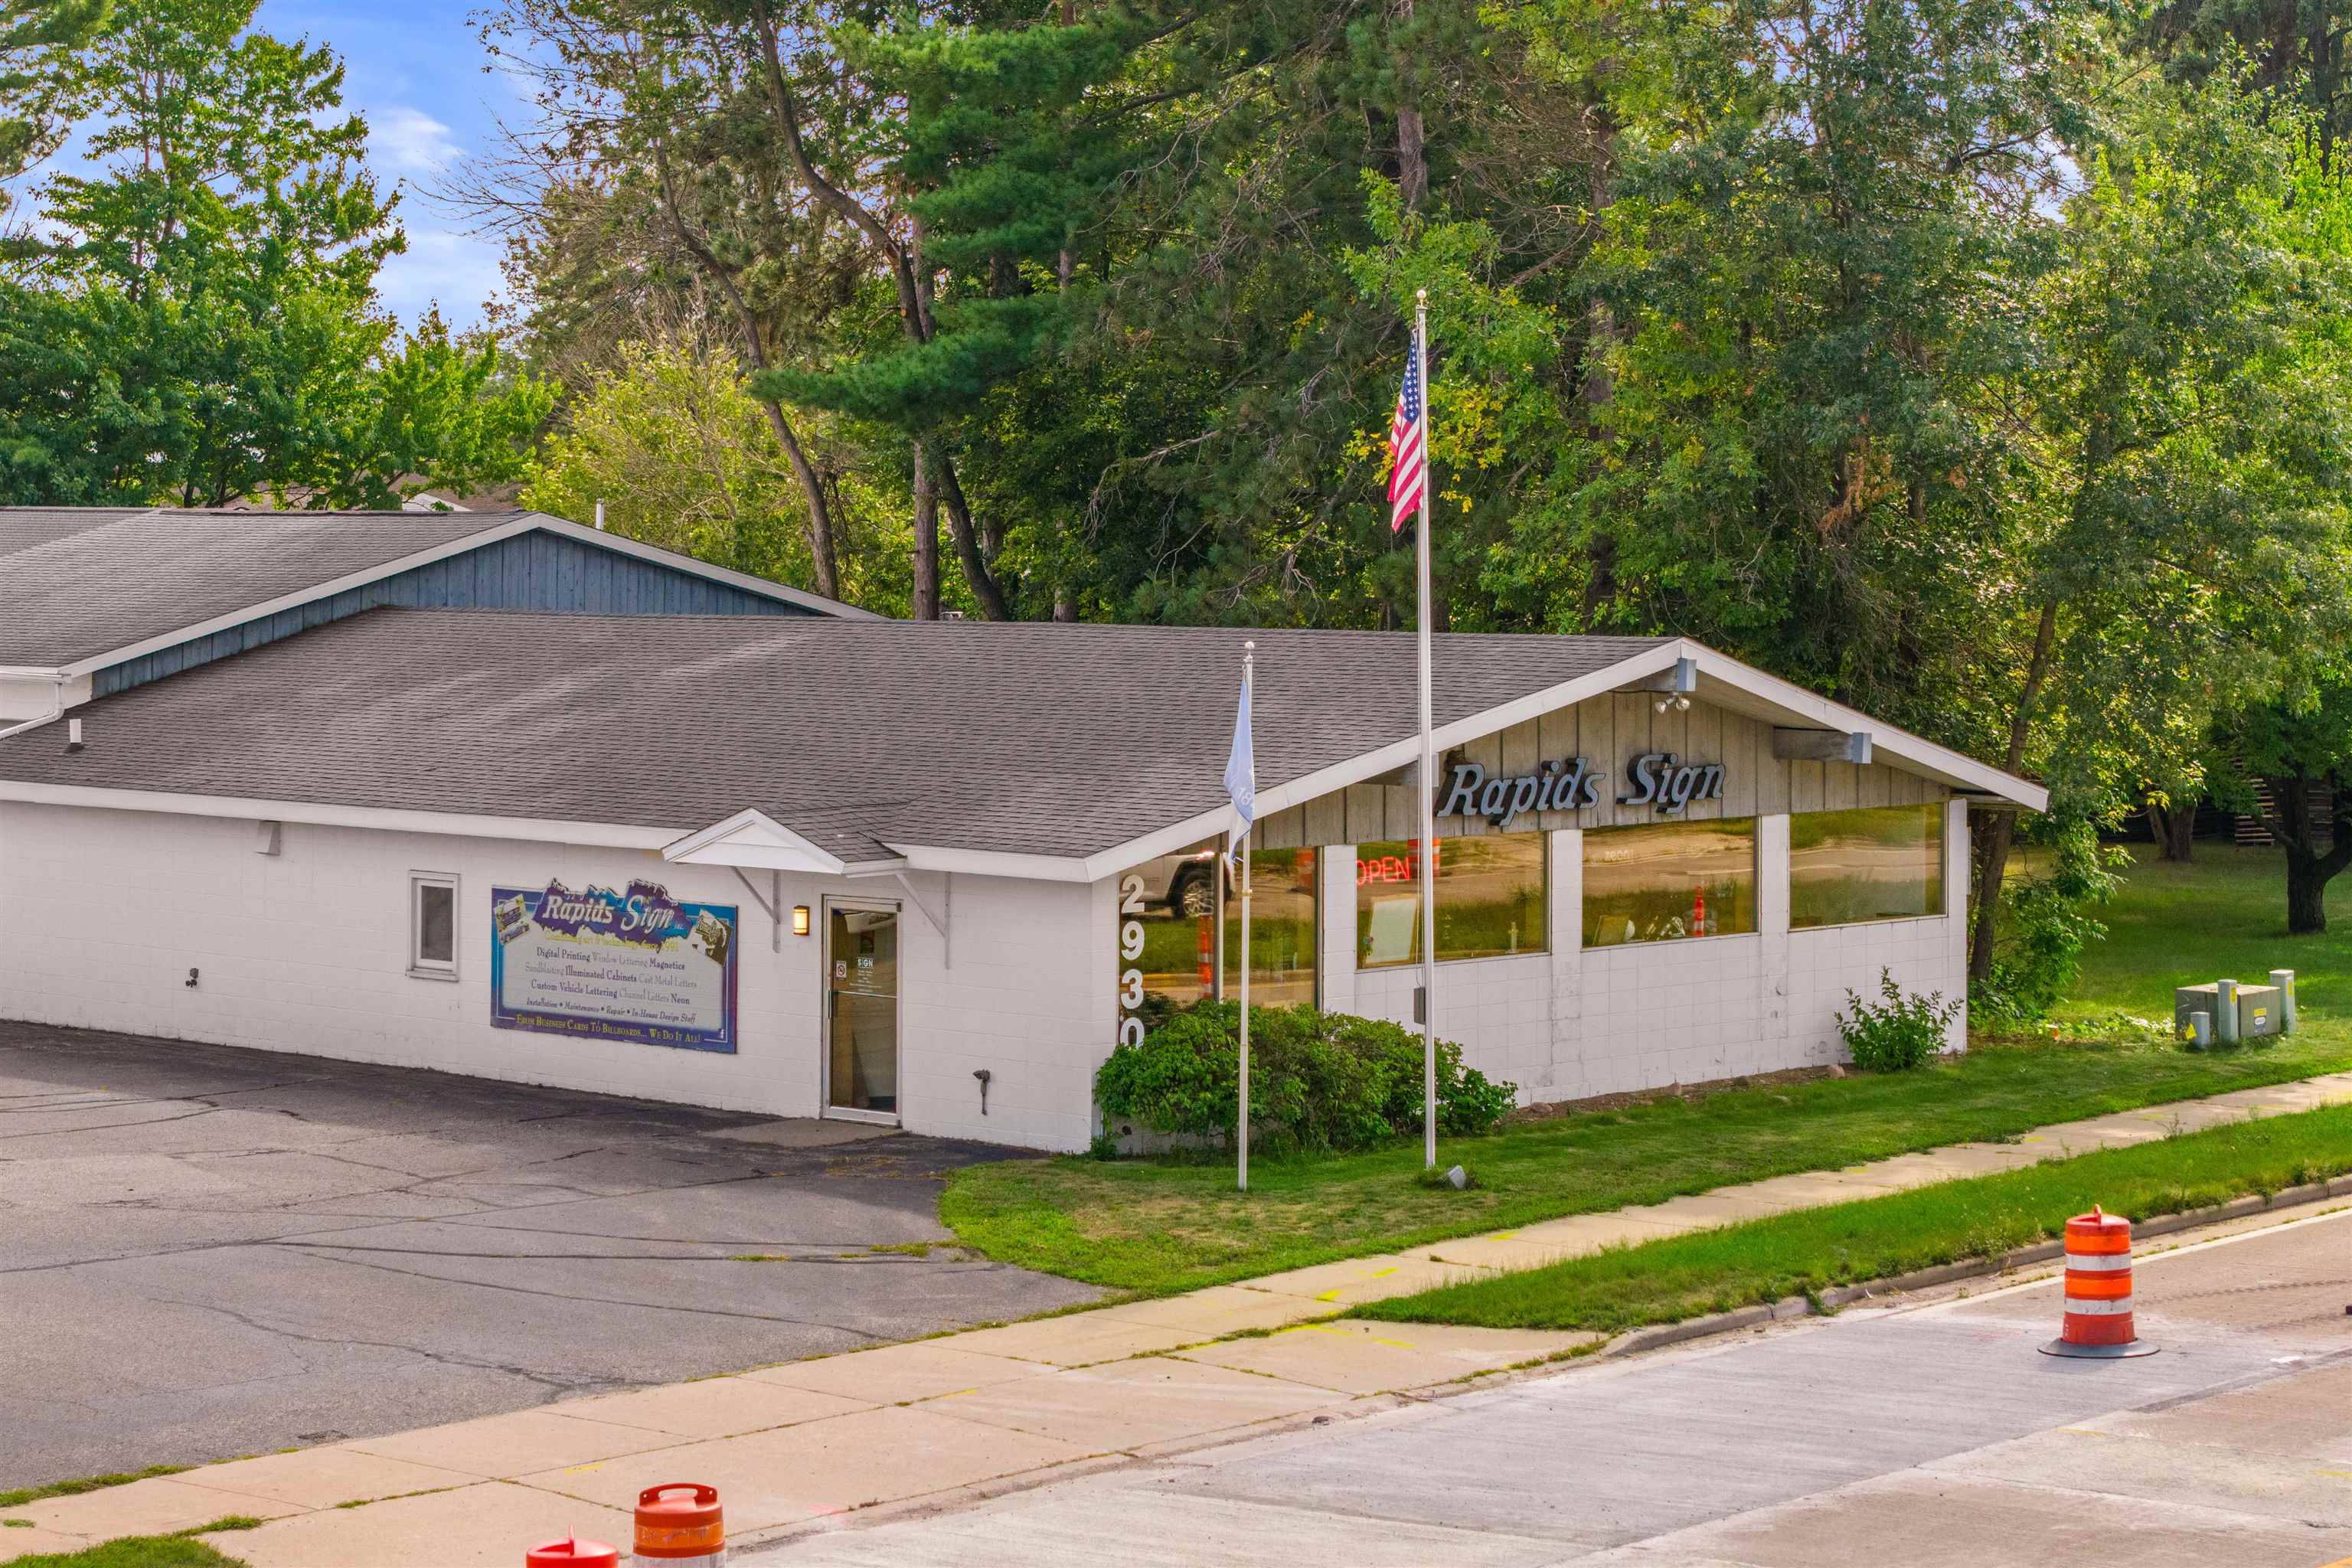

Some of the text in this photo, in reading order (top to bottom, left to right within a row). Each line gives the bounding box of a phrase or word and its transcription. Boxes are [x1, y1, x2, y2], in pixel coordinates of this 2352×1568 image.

[1436, 752, 1726, 826] Rapids Sign
[1356, 855, 1410, 886] OPEN
[541, 894, 613, 925] Rapids
[620, 894, 675, 933] Sign
[537, 946, 685, 970] Digital Printing Window Lettering Magnetics
[1120, 874, 1145, 1050] 2930
[565, 965, 604, 979] Illuminated
[606, 969, 637, 983] Cabinets
[654, 975, 673, 986] Metal
[674, 976, 697, 988] Letters
[531, 978, 690, 1005] Custom Vehicle Lettering Channel Letters Neon
[527, 997, 697, 1024] Installation Maintenance Repair In-House Design Staff
